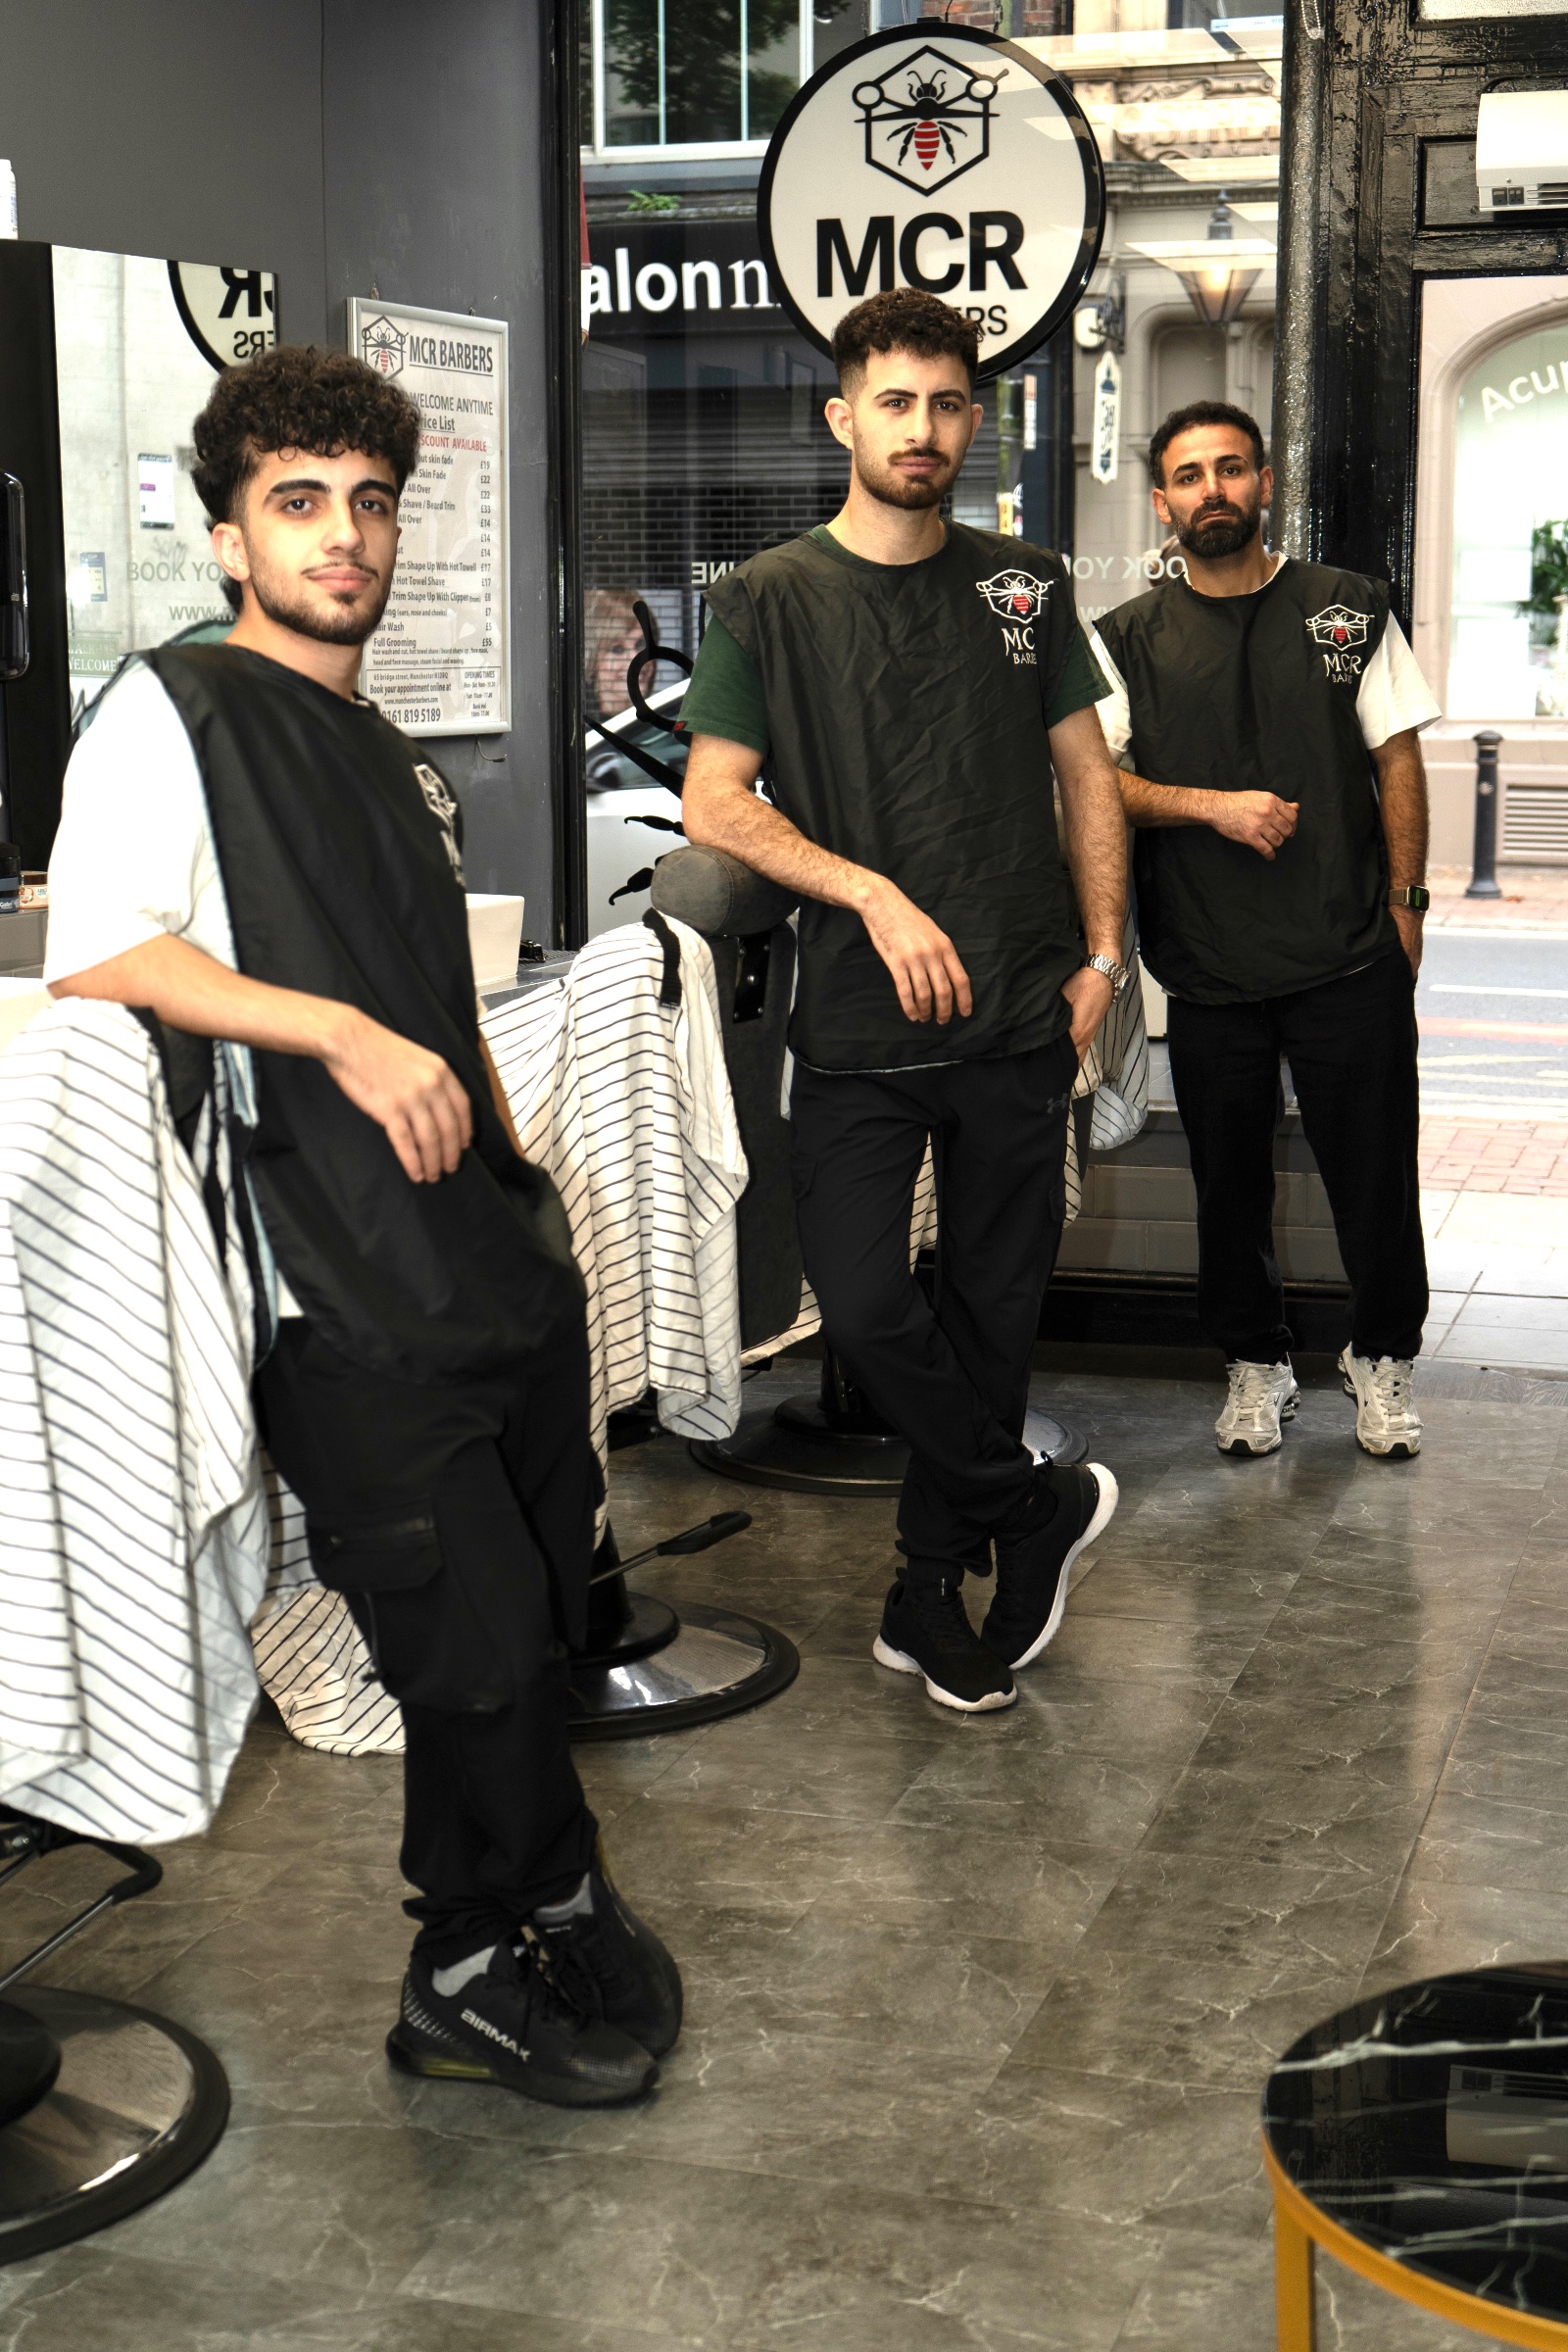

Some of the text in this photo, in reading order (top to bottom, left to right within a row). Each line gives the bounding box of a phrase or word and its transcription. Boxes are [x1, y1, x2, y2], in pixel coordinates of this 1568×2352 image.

[816, 211, 1029, 298] MCR
[410, 335, 493, 372] MCR BARBERS
[410, 392, 493, 416] WELCOME ANYTIME
[440, 416, 456, 430] List
[452, 438, 487, 452] AVAILABLE
[418, 469, 431, 478] Skin
[432, 470, 446, 479] Fade
[416, 485, 431, 494] Over
[403, 499, 422, 509] Shave
[407, 514, 422, 524] Over
[126, 562, 186, 582] BOOK
[191, 562, 225, 582] YO
[407, 561, 426, 572] Shape
[396, 576, 408, 585] Hot
[409, 576, 427, 585] Towel
[427, 576, 445, 586] Shave
[392, 591, 406, 601] Trim
[407, 592, 426, 603] Shape
[426, 592, 435, 603] Up
[387, 622, 405, 631] Wash
[373, 638, 385, 647] Full
[386, 638, 416, 648] Grooming
[1001, 626, 1035, 657] MC
[1323, 653, 1362, 677] MCR
[369, 685, 383, 694] Book
[384, 685, 396, 695] your
[396, 684, 429, 695] appointment
[430, 683, 445, 692] online
[404, 709, 419, 722] 819
[421, 708, 441, 722] 5189
